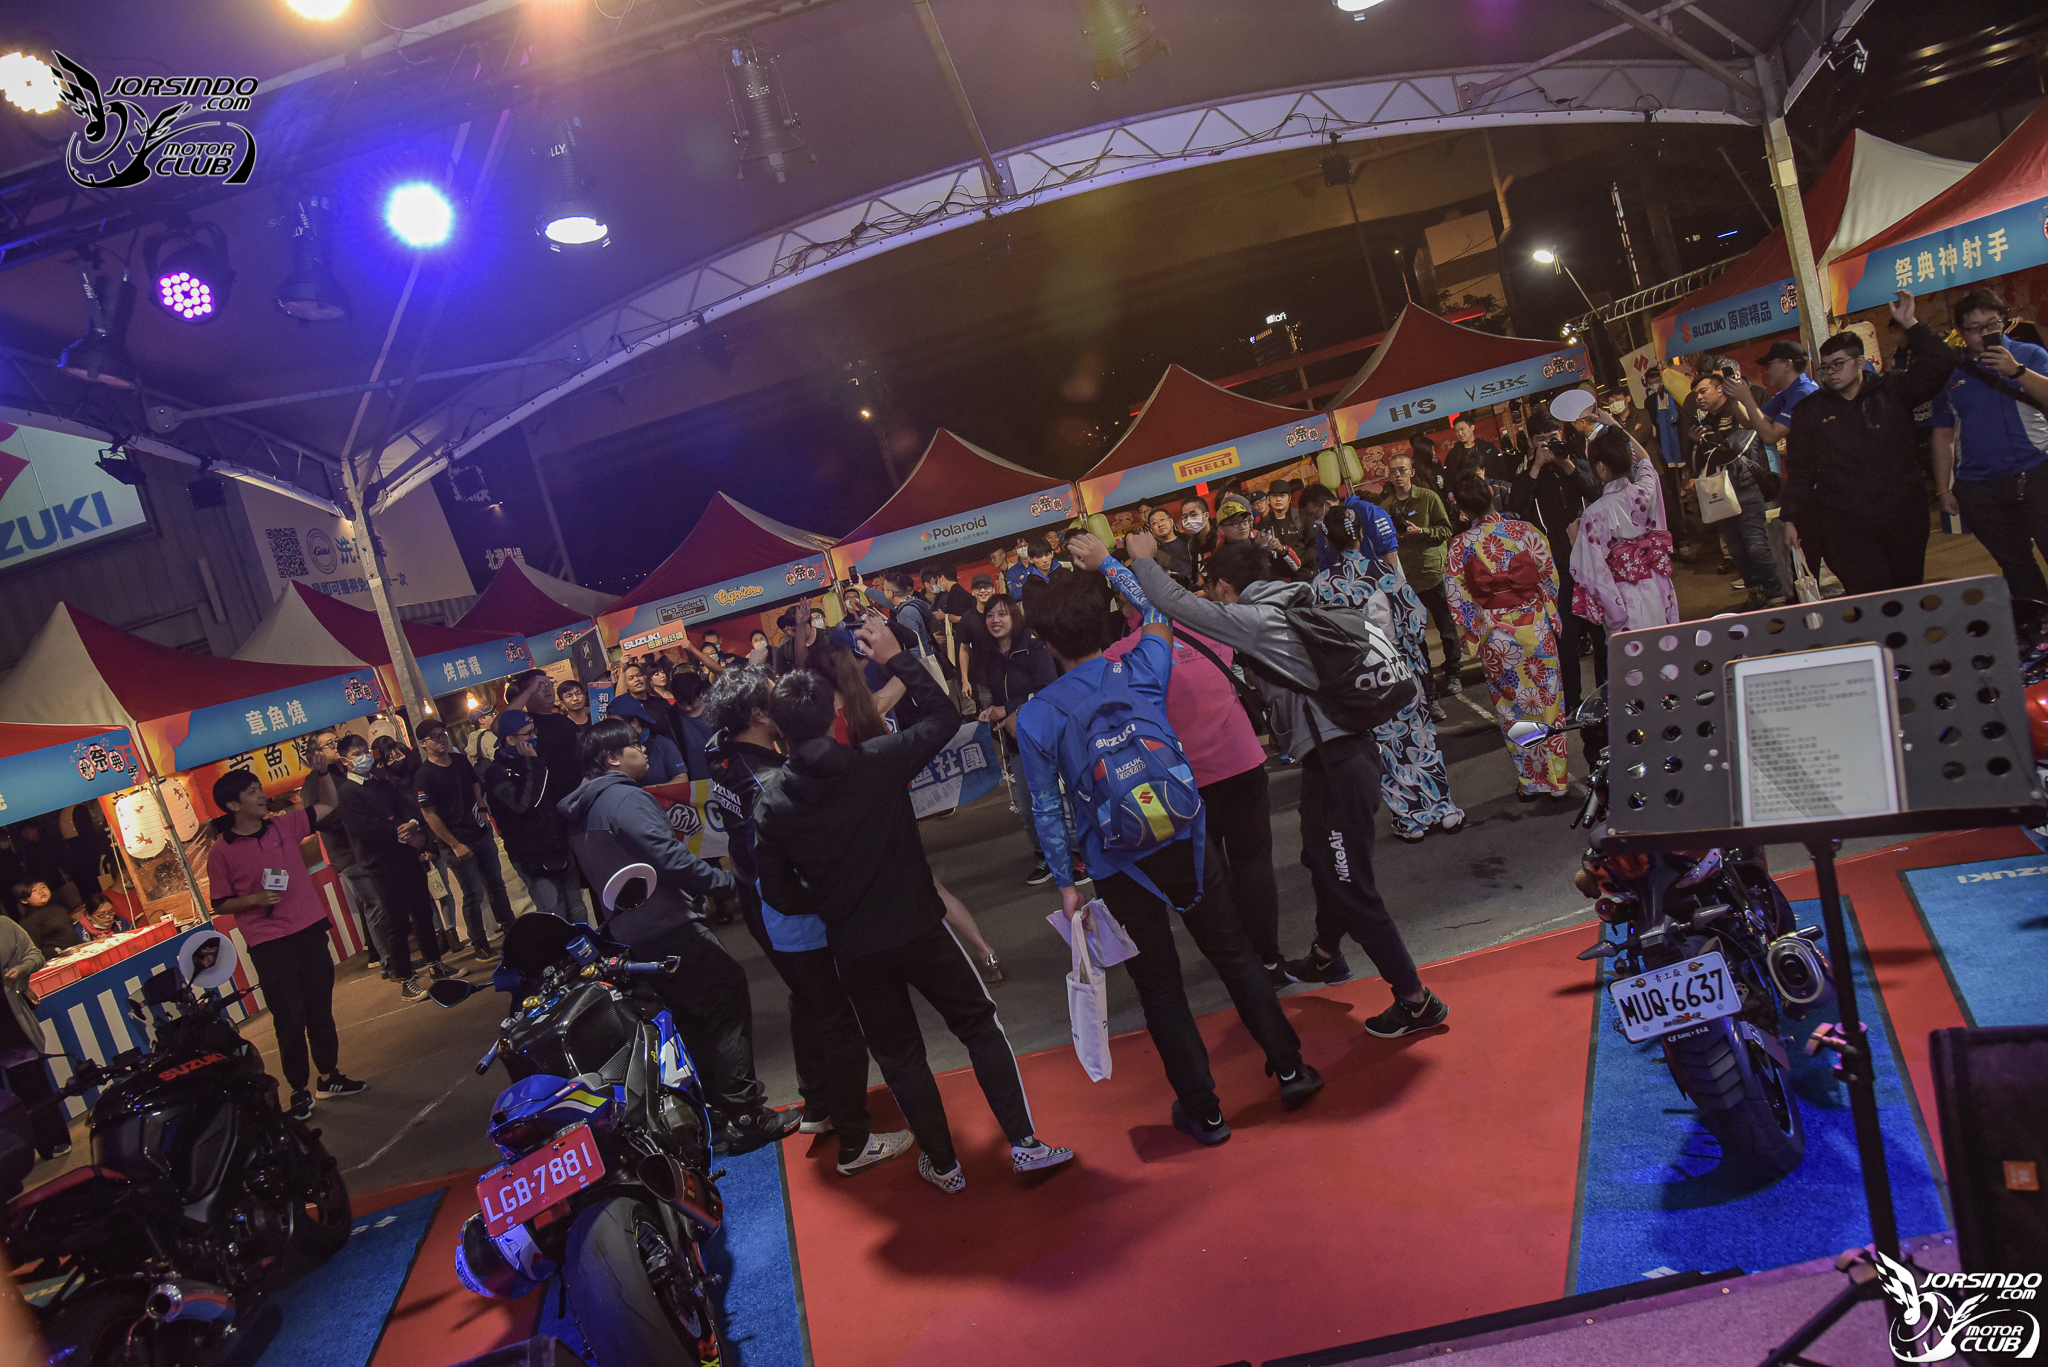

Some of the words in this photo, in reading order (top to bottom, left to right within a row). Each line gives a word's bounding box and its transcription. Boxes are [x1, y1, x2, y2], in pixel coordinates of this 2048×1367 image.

[1895, 228, 2009, 287] 祭典神射手
[1692, 318, 1726, 338] SUZUKI
[1728, 301, 1772, 331] 原廠精品
[1479, 374, 1528, 396] SBK
[1179, 452, 1233, 478] PIRELLI
[932, 515, 987, 540] Polaroid
[714, 585, 764, 607] Capricorn
[1116, 573, 1149, 607] SUZUKI
[660, 606, 676, 616] Pro
[677, 599, 704, 612] Select
[623, 631, 661, 650] SUZUKI
[443, 655, 482, 683] 烤麻糬
[245, 699, 307, 736] 章魚燒
[1095, 723, 1137, 750] SUZUKI
[79, 747, 124, 778] 秋祭典
[1619, 967, 1724, 1027] MUQ-6637
[158, 1052, 227, 1083] SUZUKI
[483, 1141, 593, 1225] LGB-7881
